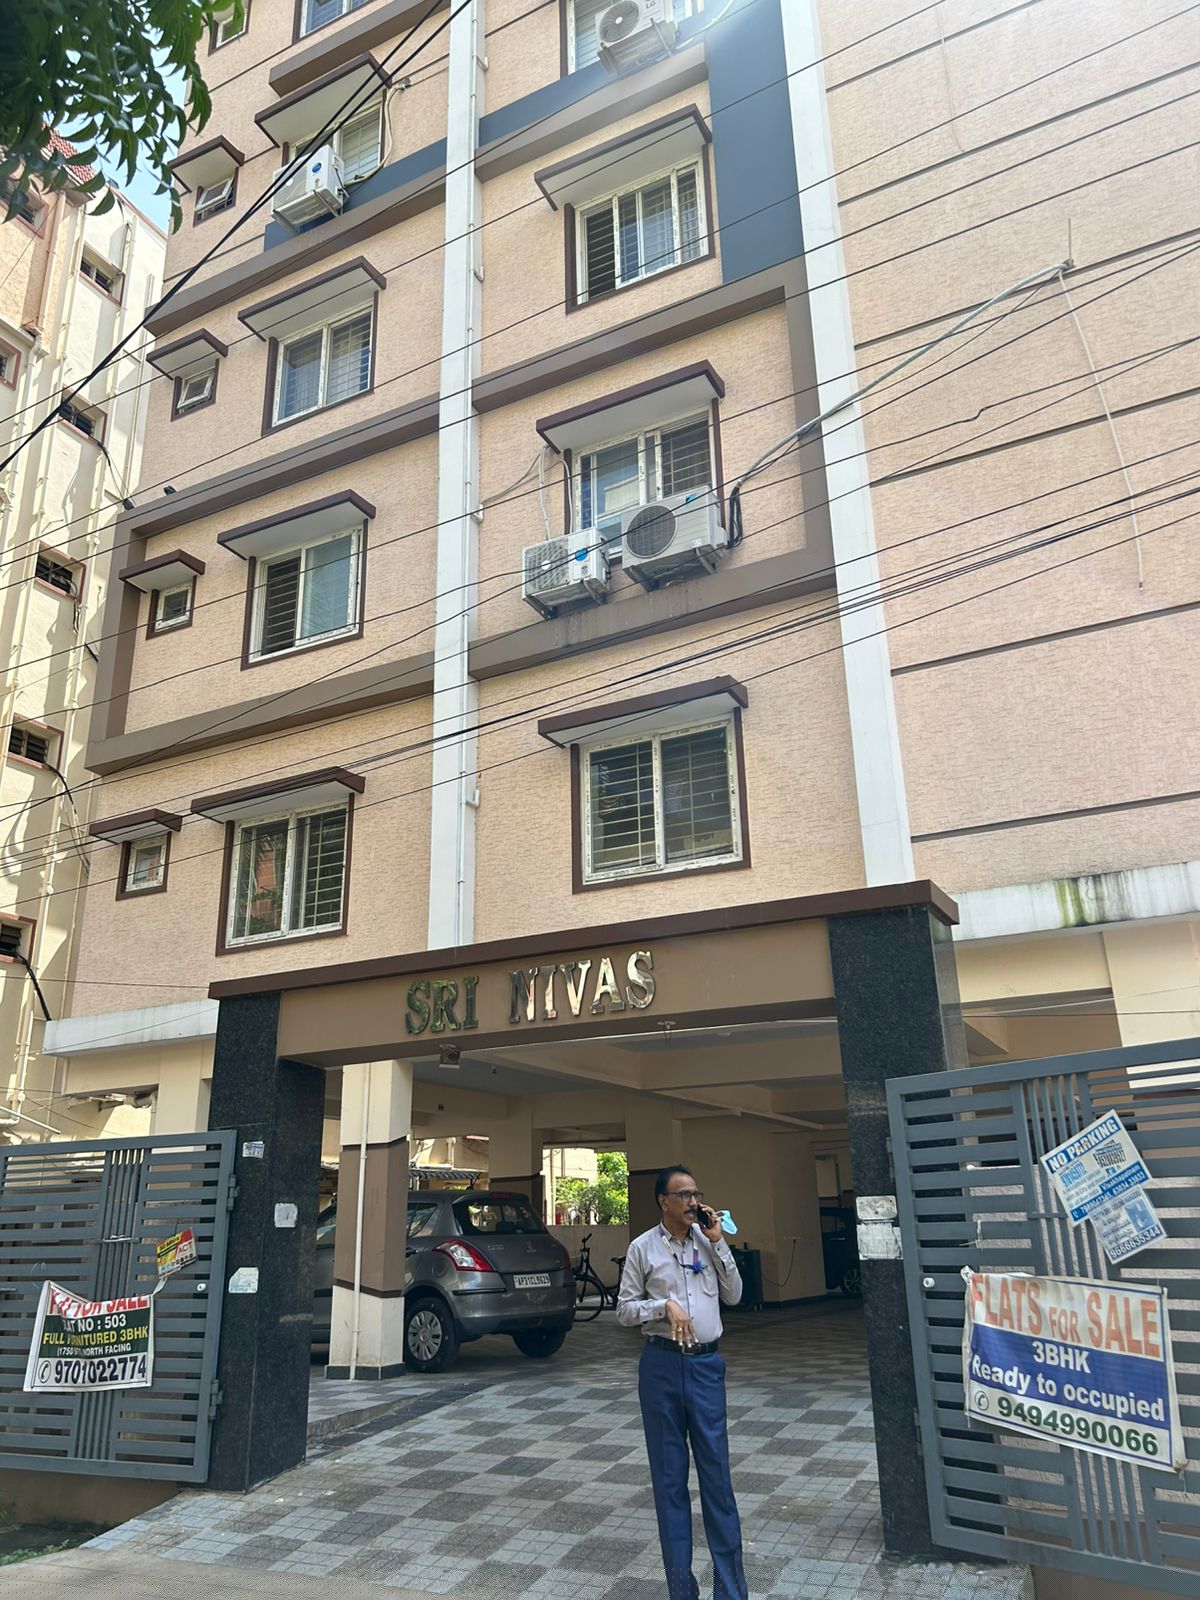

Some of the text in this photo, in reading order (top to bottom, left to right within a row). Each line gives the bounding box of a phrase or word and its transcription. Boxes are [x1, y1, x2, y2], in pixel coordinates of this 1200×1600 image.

[405, 950, 656, 1036] SRI NIVAS
[1048, 1153, 1068, 1171] NO
[1066, 1118, 1119, 1159] PARKING
[43, 1332, 65, 1345] FULL
[120, 1326, 149, 1341] 3BHK
[78, 1318, 94, 1332] NO
[105, 1314, 126, 1329] 503
[972, 1274, 1160, 1358] FLATS FOR SALE
[54, 1354, 147, 1385] 9701022774
[105, 1342, 132, 1354] FACING
[1032, 1341, 1091, 1374] 3BHK
[972, 1354, 1165, 1422] Ready to occupied
[998, 1396, 1159, 1456] 9494990066
